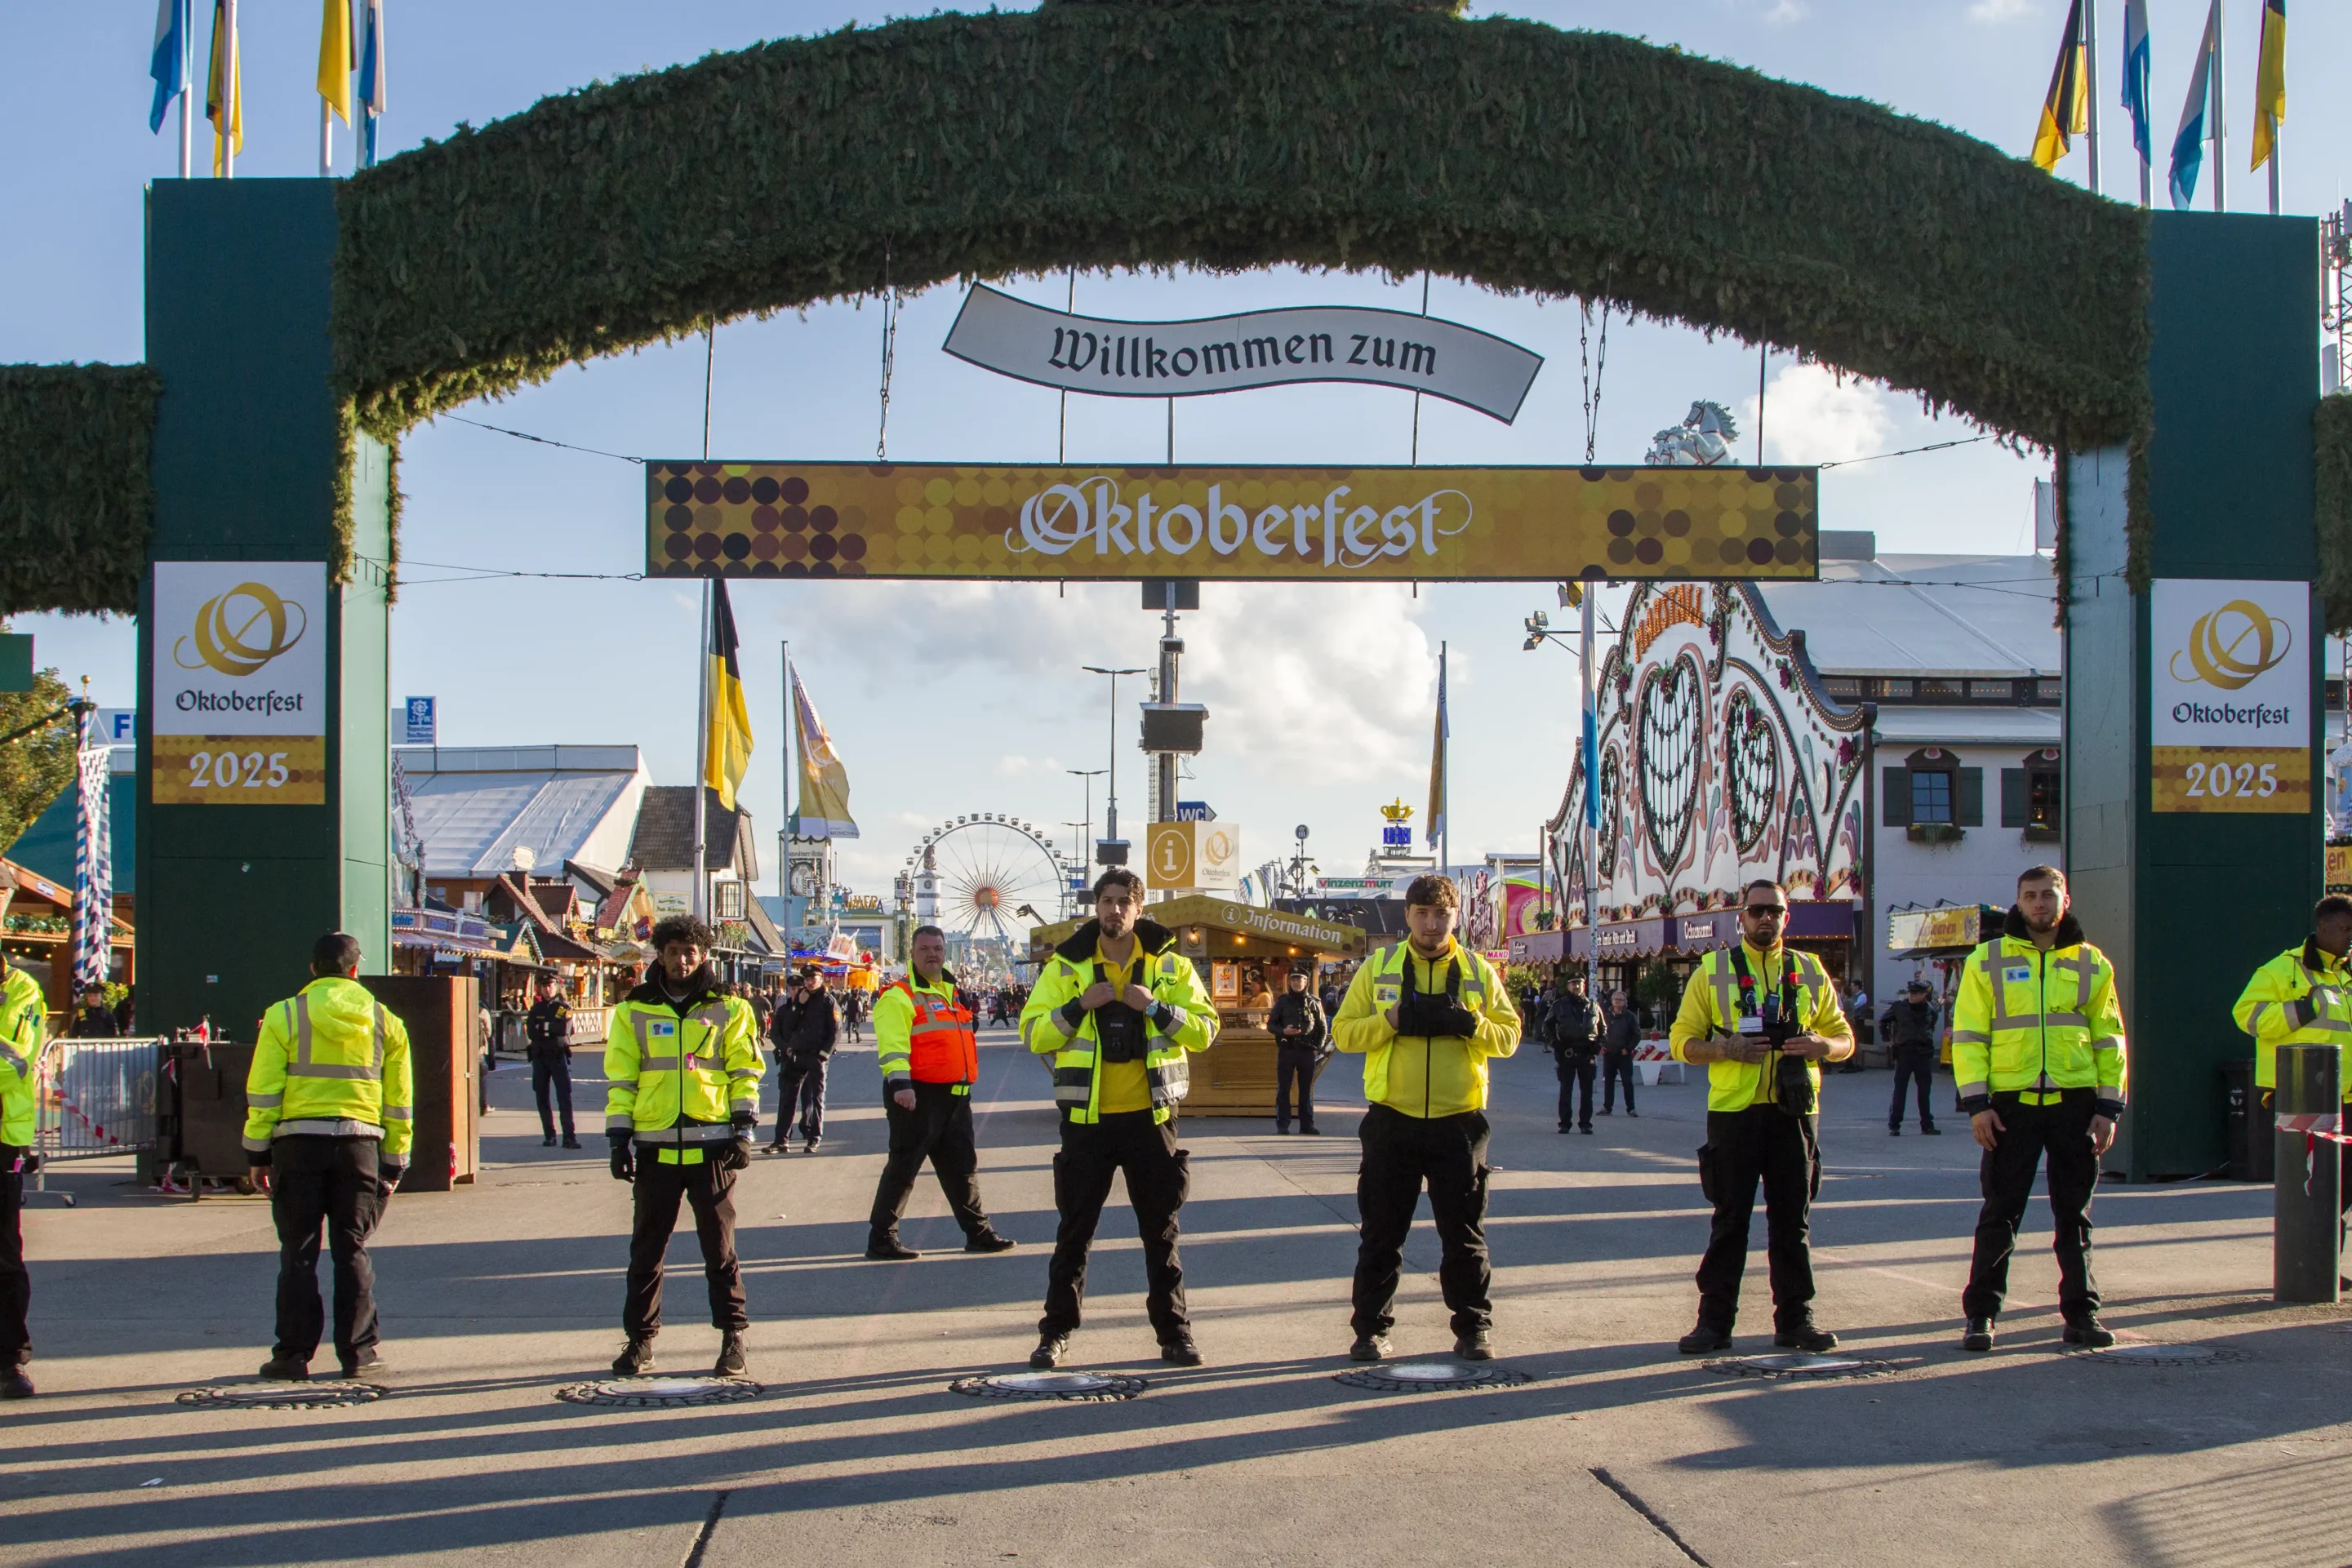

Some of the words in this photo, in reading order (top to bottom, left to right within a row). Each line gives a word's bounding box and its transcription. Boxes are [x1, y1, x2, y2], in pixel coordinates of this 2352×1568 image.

[1047, 326, 1335, 379] Willkommen
[1346, 333, 1437, 377] zum
[1005, 476, 1472, 568] Oktoberfest
[1634, 584, 1703, 664] MARSTALL
[176, 690, 303, 716] Oktoberfest
[2172, 702, 2290, 729] Oktoberfest
[189, 751, 289, 788] 2025
[2185, 762, 2278, 797] 2025
[1180, 808, 1205, 821] WC
[1202, 868, 1231, 877] Oktoberfest
[1318, 877, 1394, 888] vinzenzmurr
[1243, 909, 1341, 944] Information
